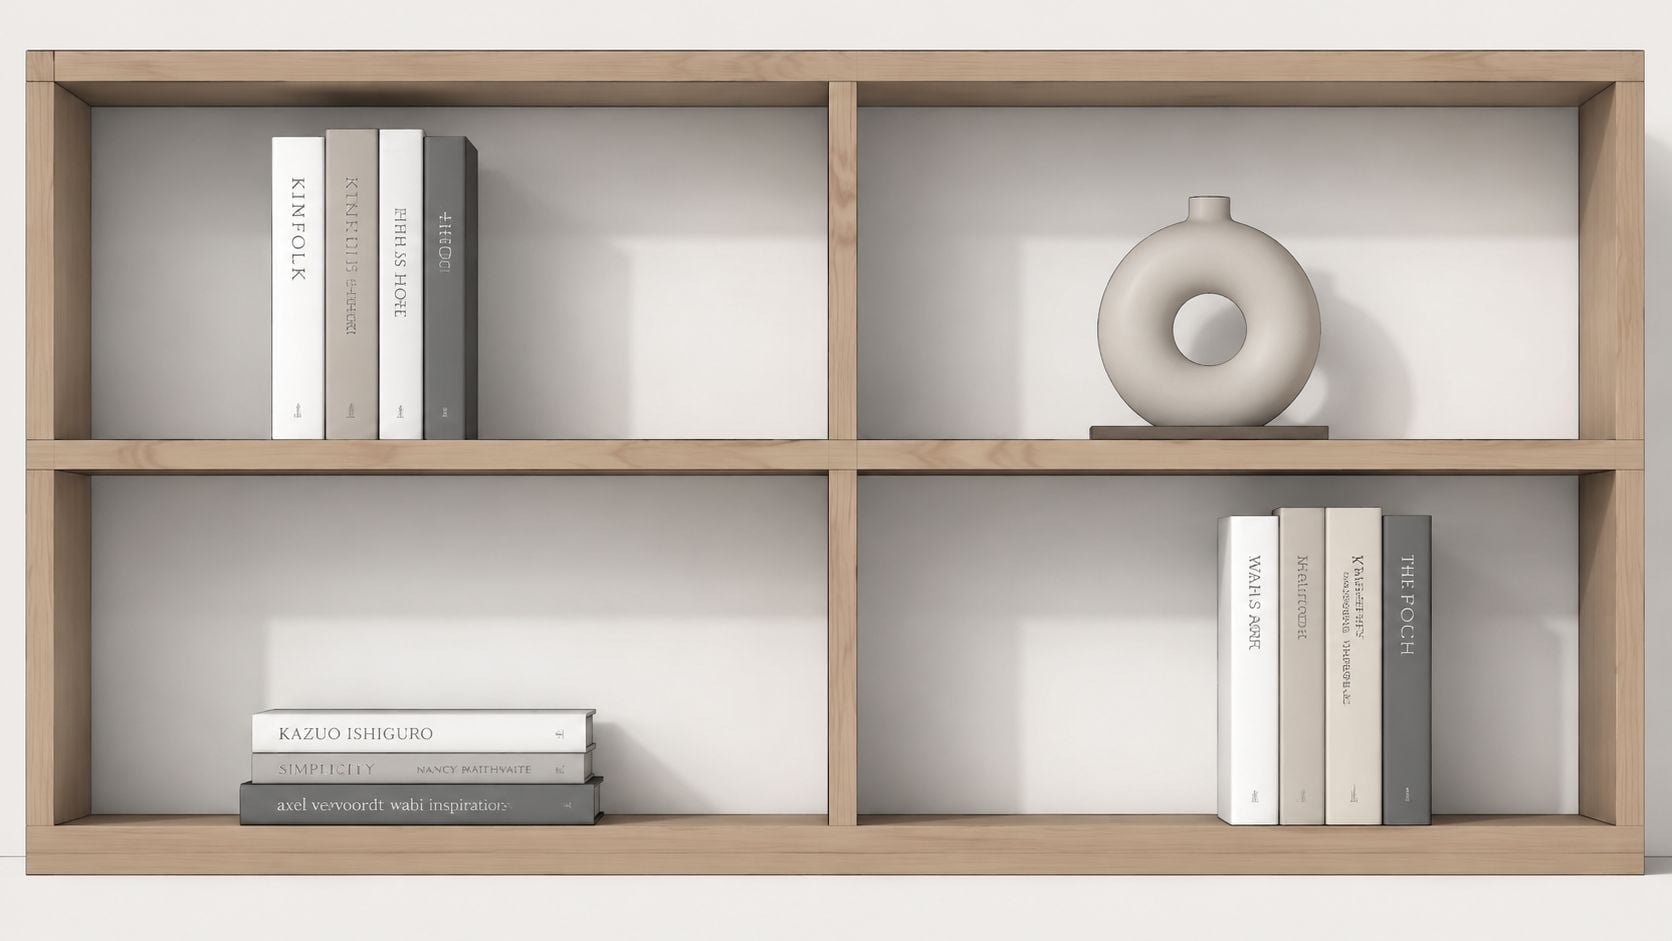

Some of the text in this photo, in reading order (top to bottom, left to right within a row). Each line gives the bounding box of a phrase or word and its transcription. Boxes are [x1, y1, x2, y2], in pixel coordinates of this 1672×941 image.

[290, 176, 306, 281] KINFOLK
[1400, 554, 1416, 589] THE
[279, 727, 433, 741] KAZUO ISHIGURO
[416, 764, 458, 775] NANCY
[276, 797, 307, 812] axel
[312, 797, 384, 812] vervoordt
[390, 798, 424, 812] wabi
